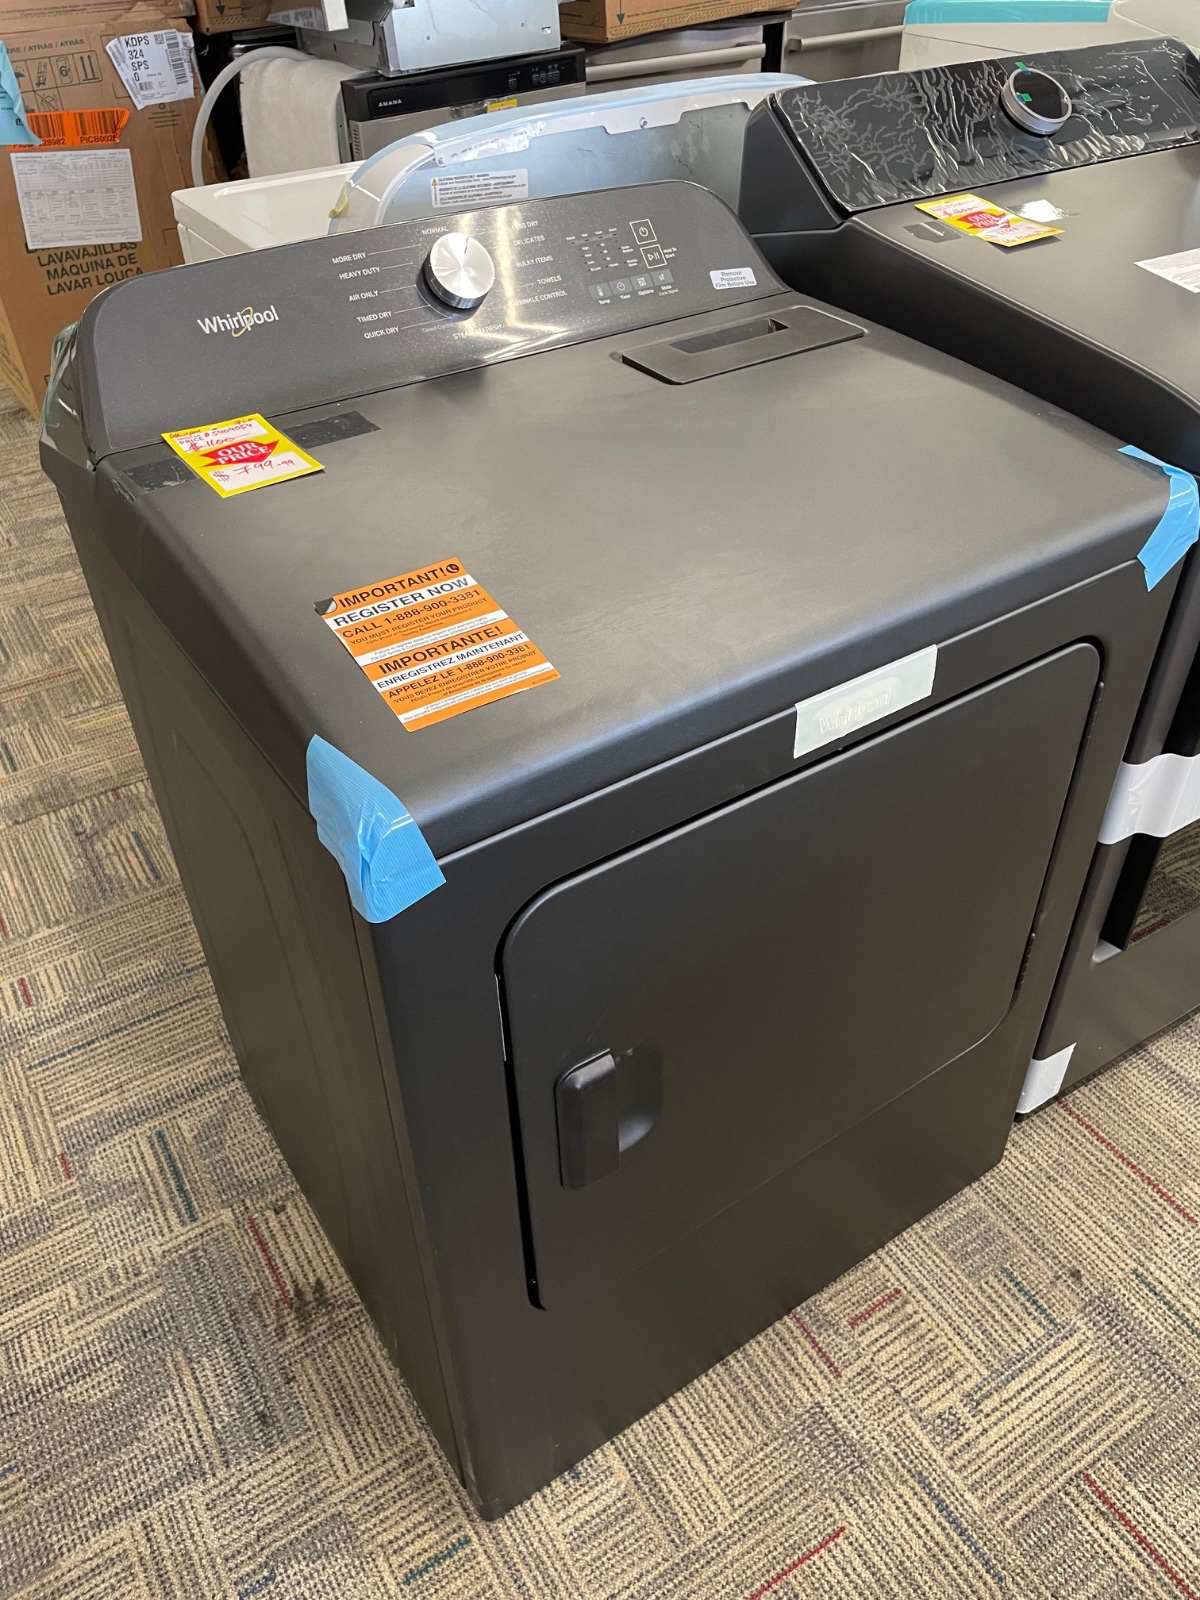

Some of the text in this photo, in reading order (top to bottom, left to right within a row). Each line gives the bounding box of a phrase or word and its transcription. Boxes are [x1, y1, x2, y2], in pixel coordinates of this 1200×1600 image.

[124, 35, 150, 48] KDPS
[128, 49, 145, 61] 324
[131, 60, 150, 72] SPS
[378, 98, 403, 107] AMANA
[421, 226, 449, 236] NORMAL
[513, 235, 546, 247] DELICATES
[37, 242, 138, 267] LAVAVAJILLAS
[332, 252, 367, 264] MORE DRY
[515, 255, 554, 268] BULKY ITEMS
[46, 253, 138, 281] MÁQUINA DE
[339, 266, 381, 280] HEAVY DUTY
[46, 277, 93, 296] LAVAR
[536, 275, 562, 285] TOWELS
[349, 290, 379, 302] AIR ONLY
[539, 290, 569, 301] CONTROL
[197, 304, 279, 337] Whirlpool
[357, 311, 393, 323] TIMED DRY
[363, 326, 400, 339] QUICK DRY
[179, 437, 204, 445] PRICE
[217, 442, 261, 457] OUR
[217, 446, 272, 464] PRICE
[338, 567, 447, 608] IMPORTANT!
[335, 577, 470, 626] REGISTER NOW
[341, 620, 382, 638] CALL
[383, 588, 481, 625] 1-888-900-3381
[350, 597, 488, 645] YOU MUST REGISTER YOUR PRODUCT
[377, 625, 504, 674] IMPORTANTE!
[376, 657, 456, 688] ENREGISTREZ
[454, 633, 526, 661] MAINTENANT
[386, 675, 440, 698] APPELEZ
[439, 669, 456, 679] LE
[455, 643, 531, 673] 1-888-900-3381
[393, 692, 415, 703] VOUS
[414, 684, 438, 696] DEVEZ
[437, 668, 485, 687] ENREGISTRER
[484, 660, 508, 671] VOTRE
[507, 650, 537, 663] PRODUIT
